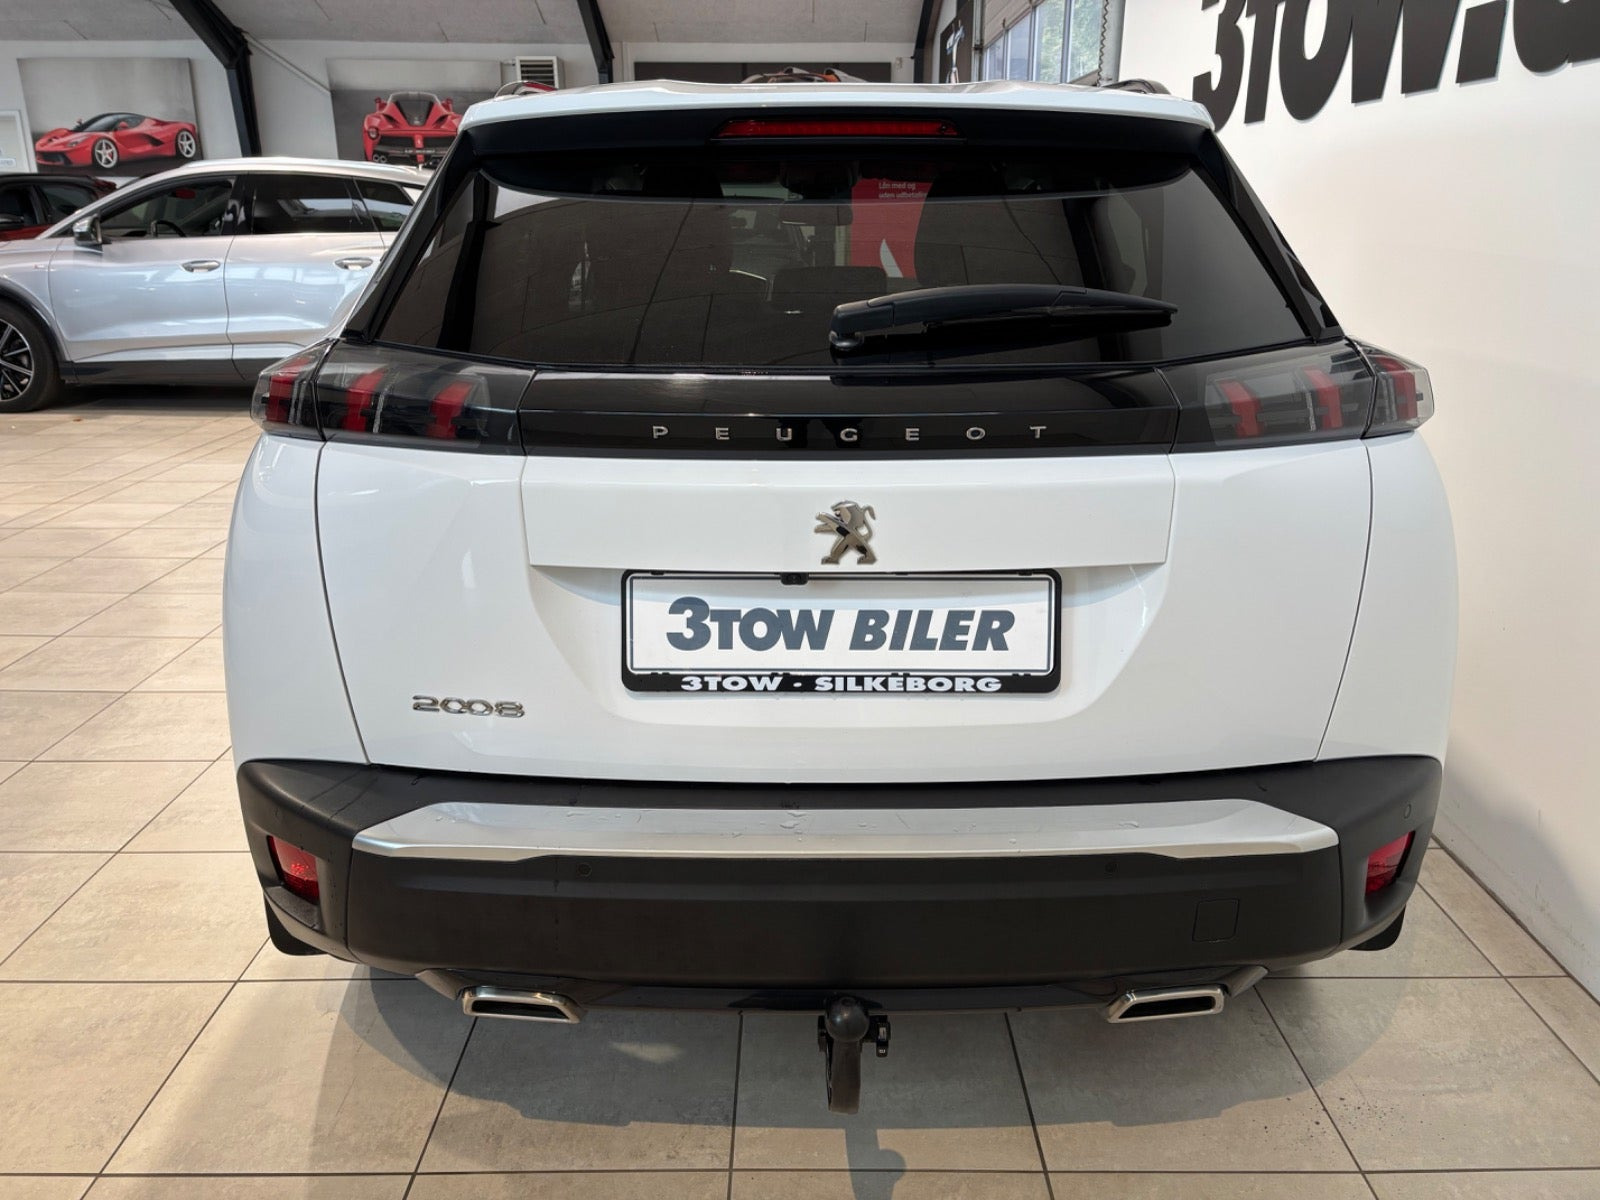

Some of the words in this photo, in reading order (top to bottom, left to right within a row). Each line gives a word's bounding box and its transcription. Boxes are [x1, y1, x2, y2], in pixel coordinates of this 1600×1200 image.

[907, 183, 916, 191] og
[652, 425, 1047, 441] PEUGEOT
[666, 596, 835, 652] 3TOW
[849, 609, 1015, 652] BILER
[680, 676, 783, 692] 3TOW
[814, 676, 1003, 693] SILKEBORG
[412, 695, 525, 718] 2008
